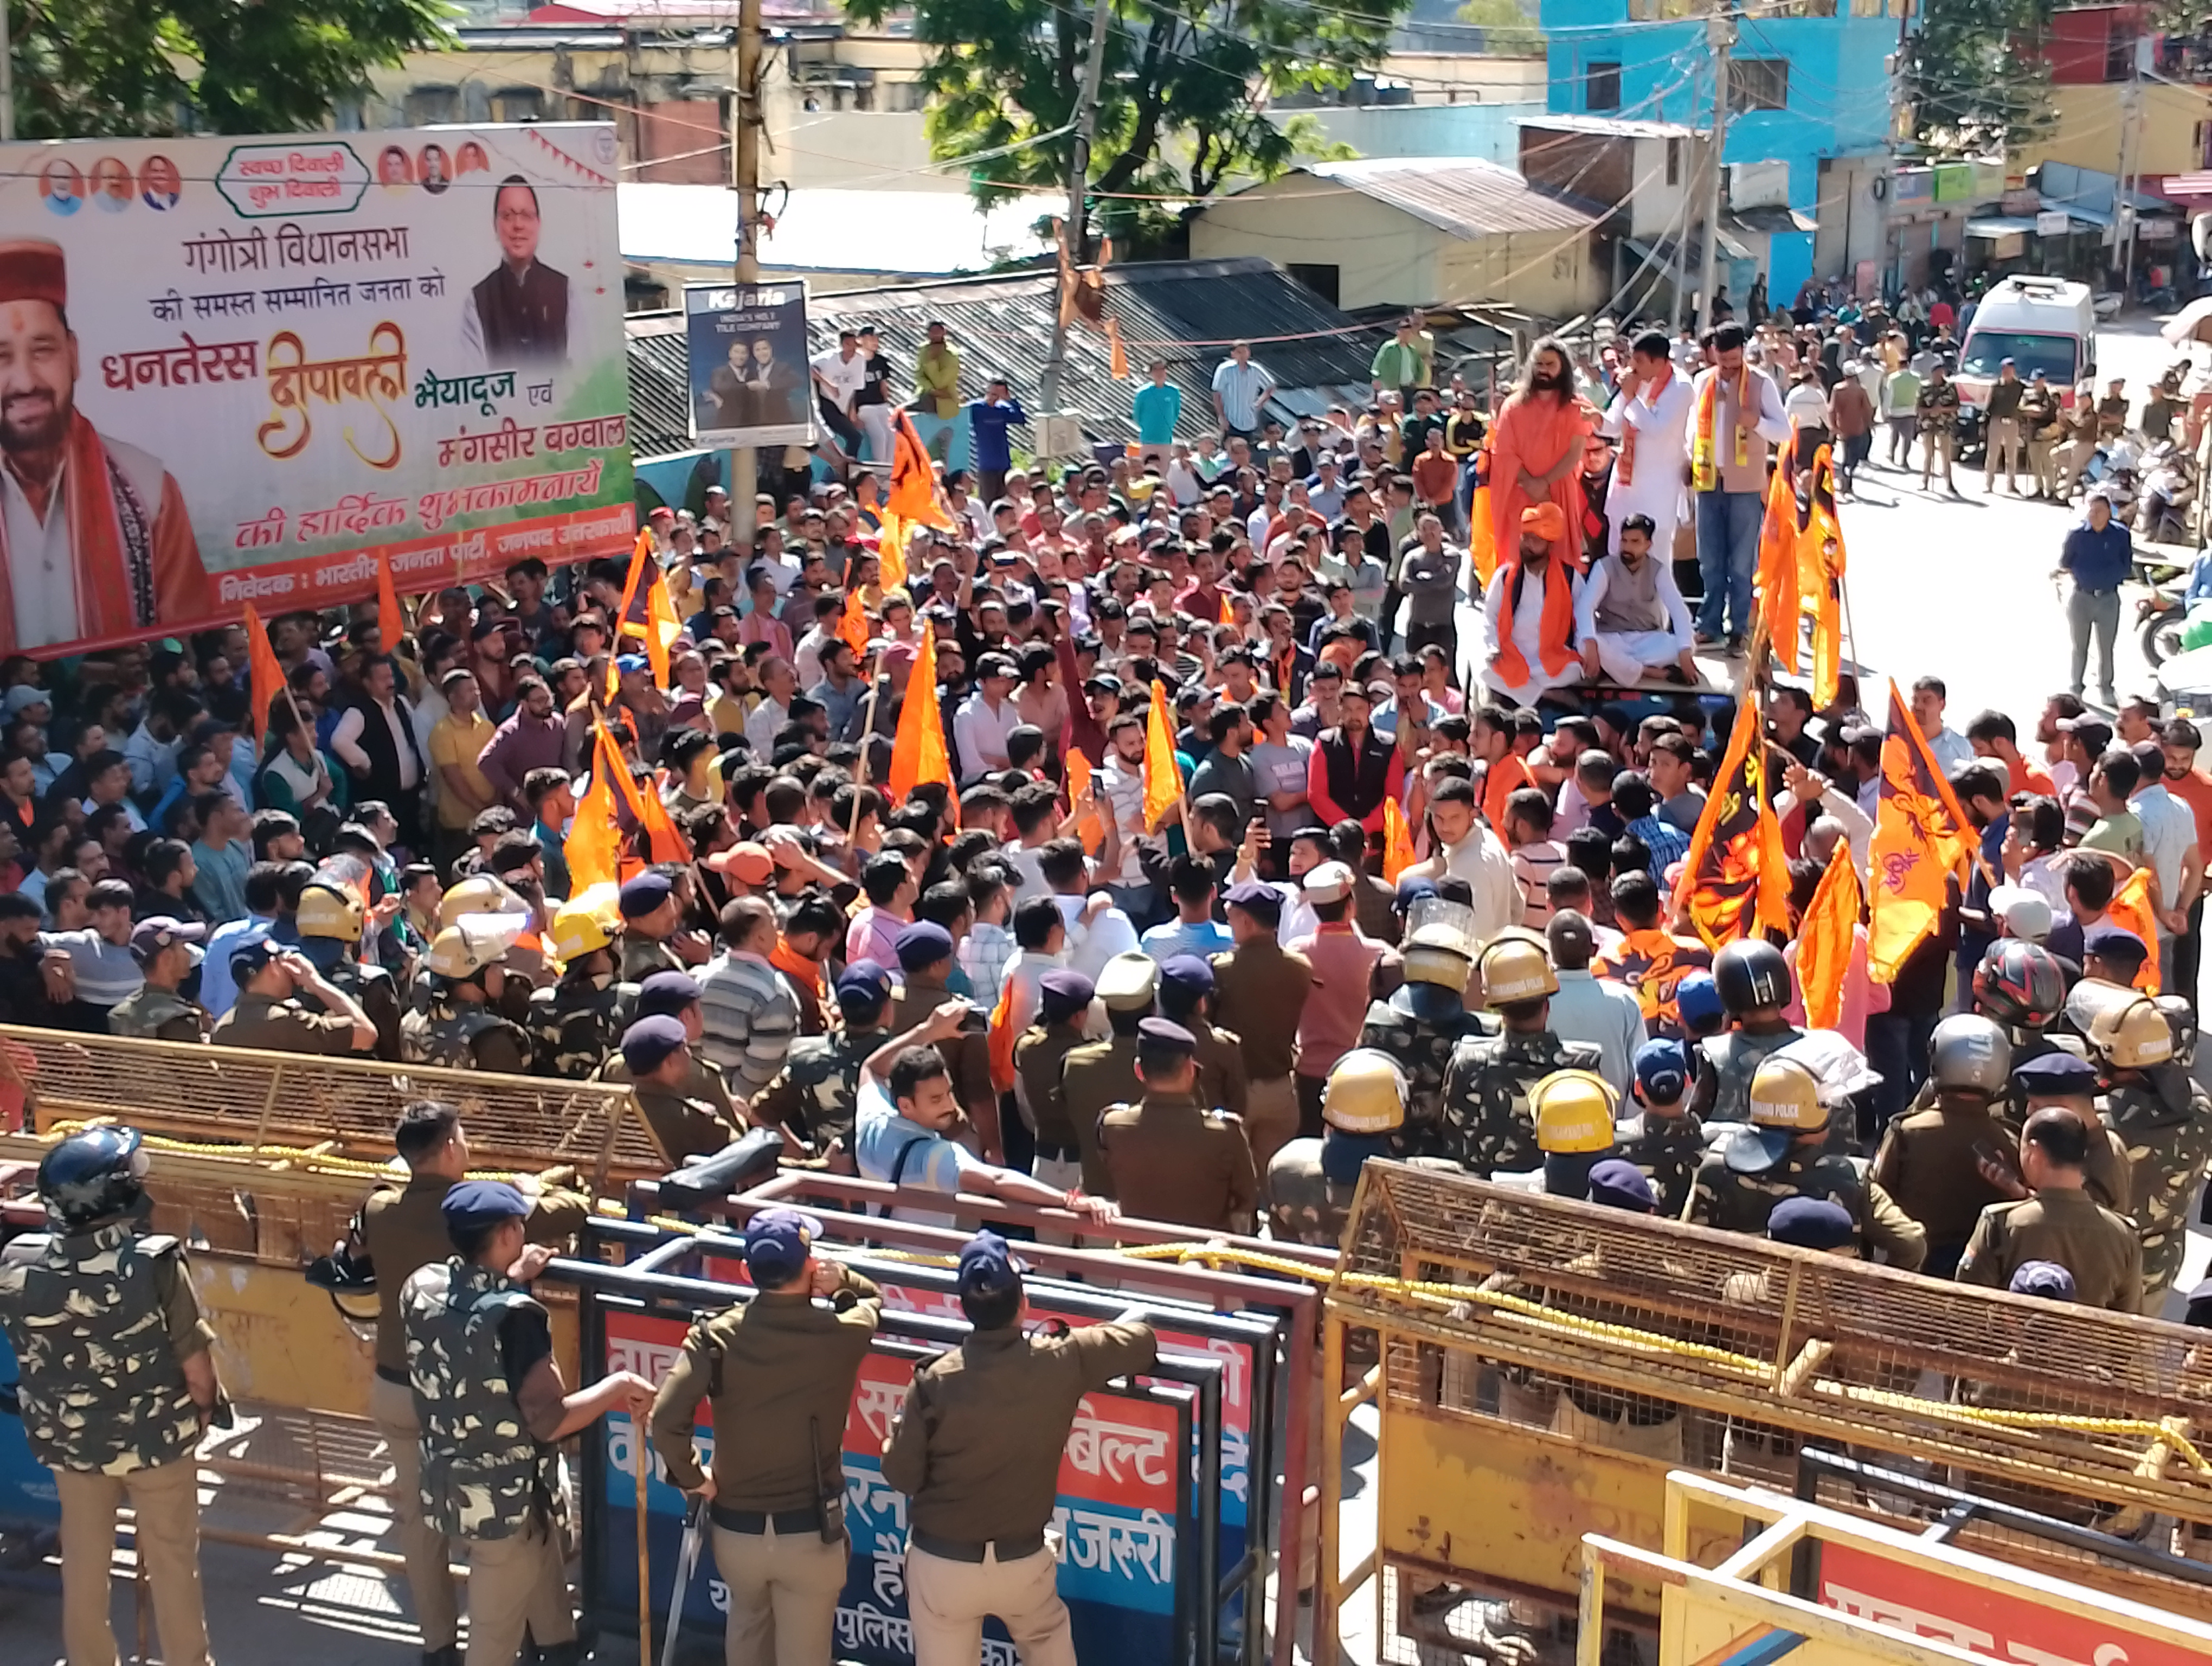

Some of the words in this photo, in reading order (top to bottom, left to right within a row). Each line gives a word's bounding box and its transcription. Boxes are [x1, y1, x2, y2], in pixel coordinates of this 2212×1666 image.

[182, 225, 268, 274] गंगोत्री
[274, 222, 409, 269] विधानसभा
[147, 287, 184, 323] की
[189, 291, 256, 320] समस्त
[261, 276, 352, 312] सम्मानित
[356, 278, 412, 302] जनता
[417, 267, 446, 298] को
[708, 287, 786, 312] Kajaria
[100, 330, 260, 392] धनतेरस
[414, 368, 517, 416] भैयादूज
[437, 416, 537, 468] मंगसीर
[543, 414, 627, 453] बग्वाल
[235, 505, 287, 548] की
[297, 492, 408, 542] हार्दिक
[1067, 1398, 1169, 1485] बेल्ट
[835, 1601, 915, 1655] पुलिस
